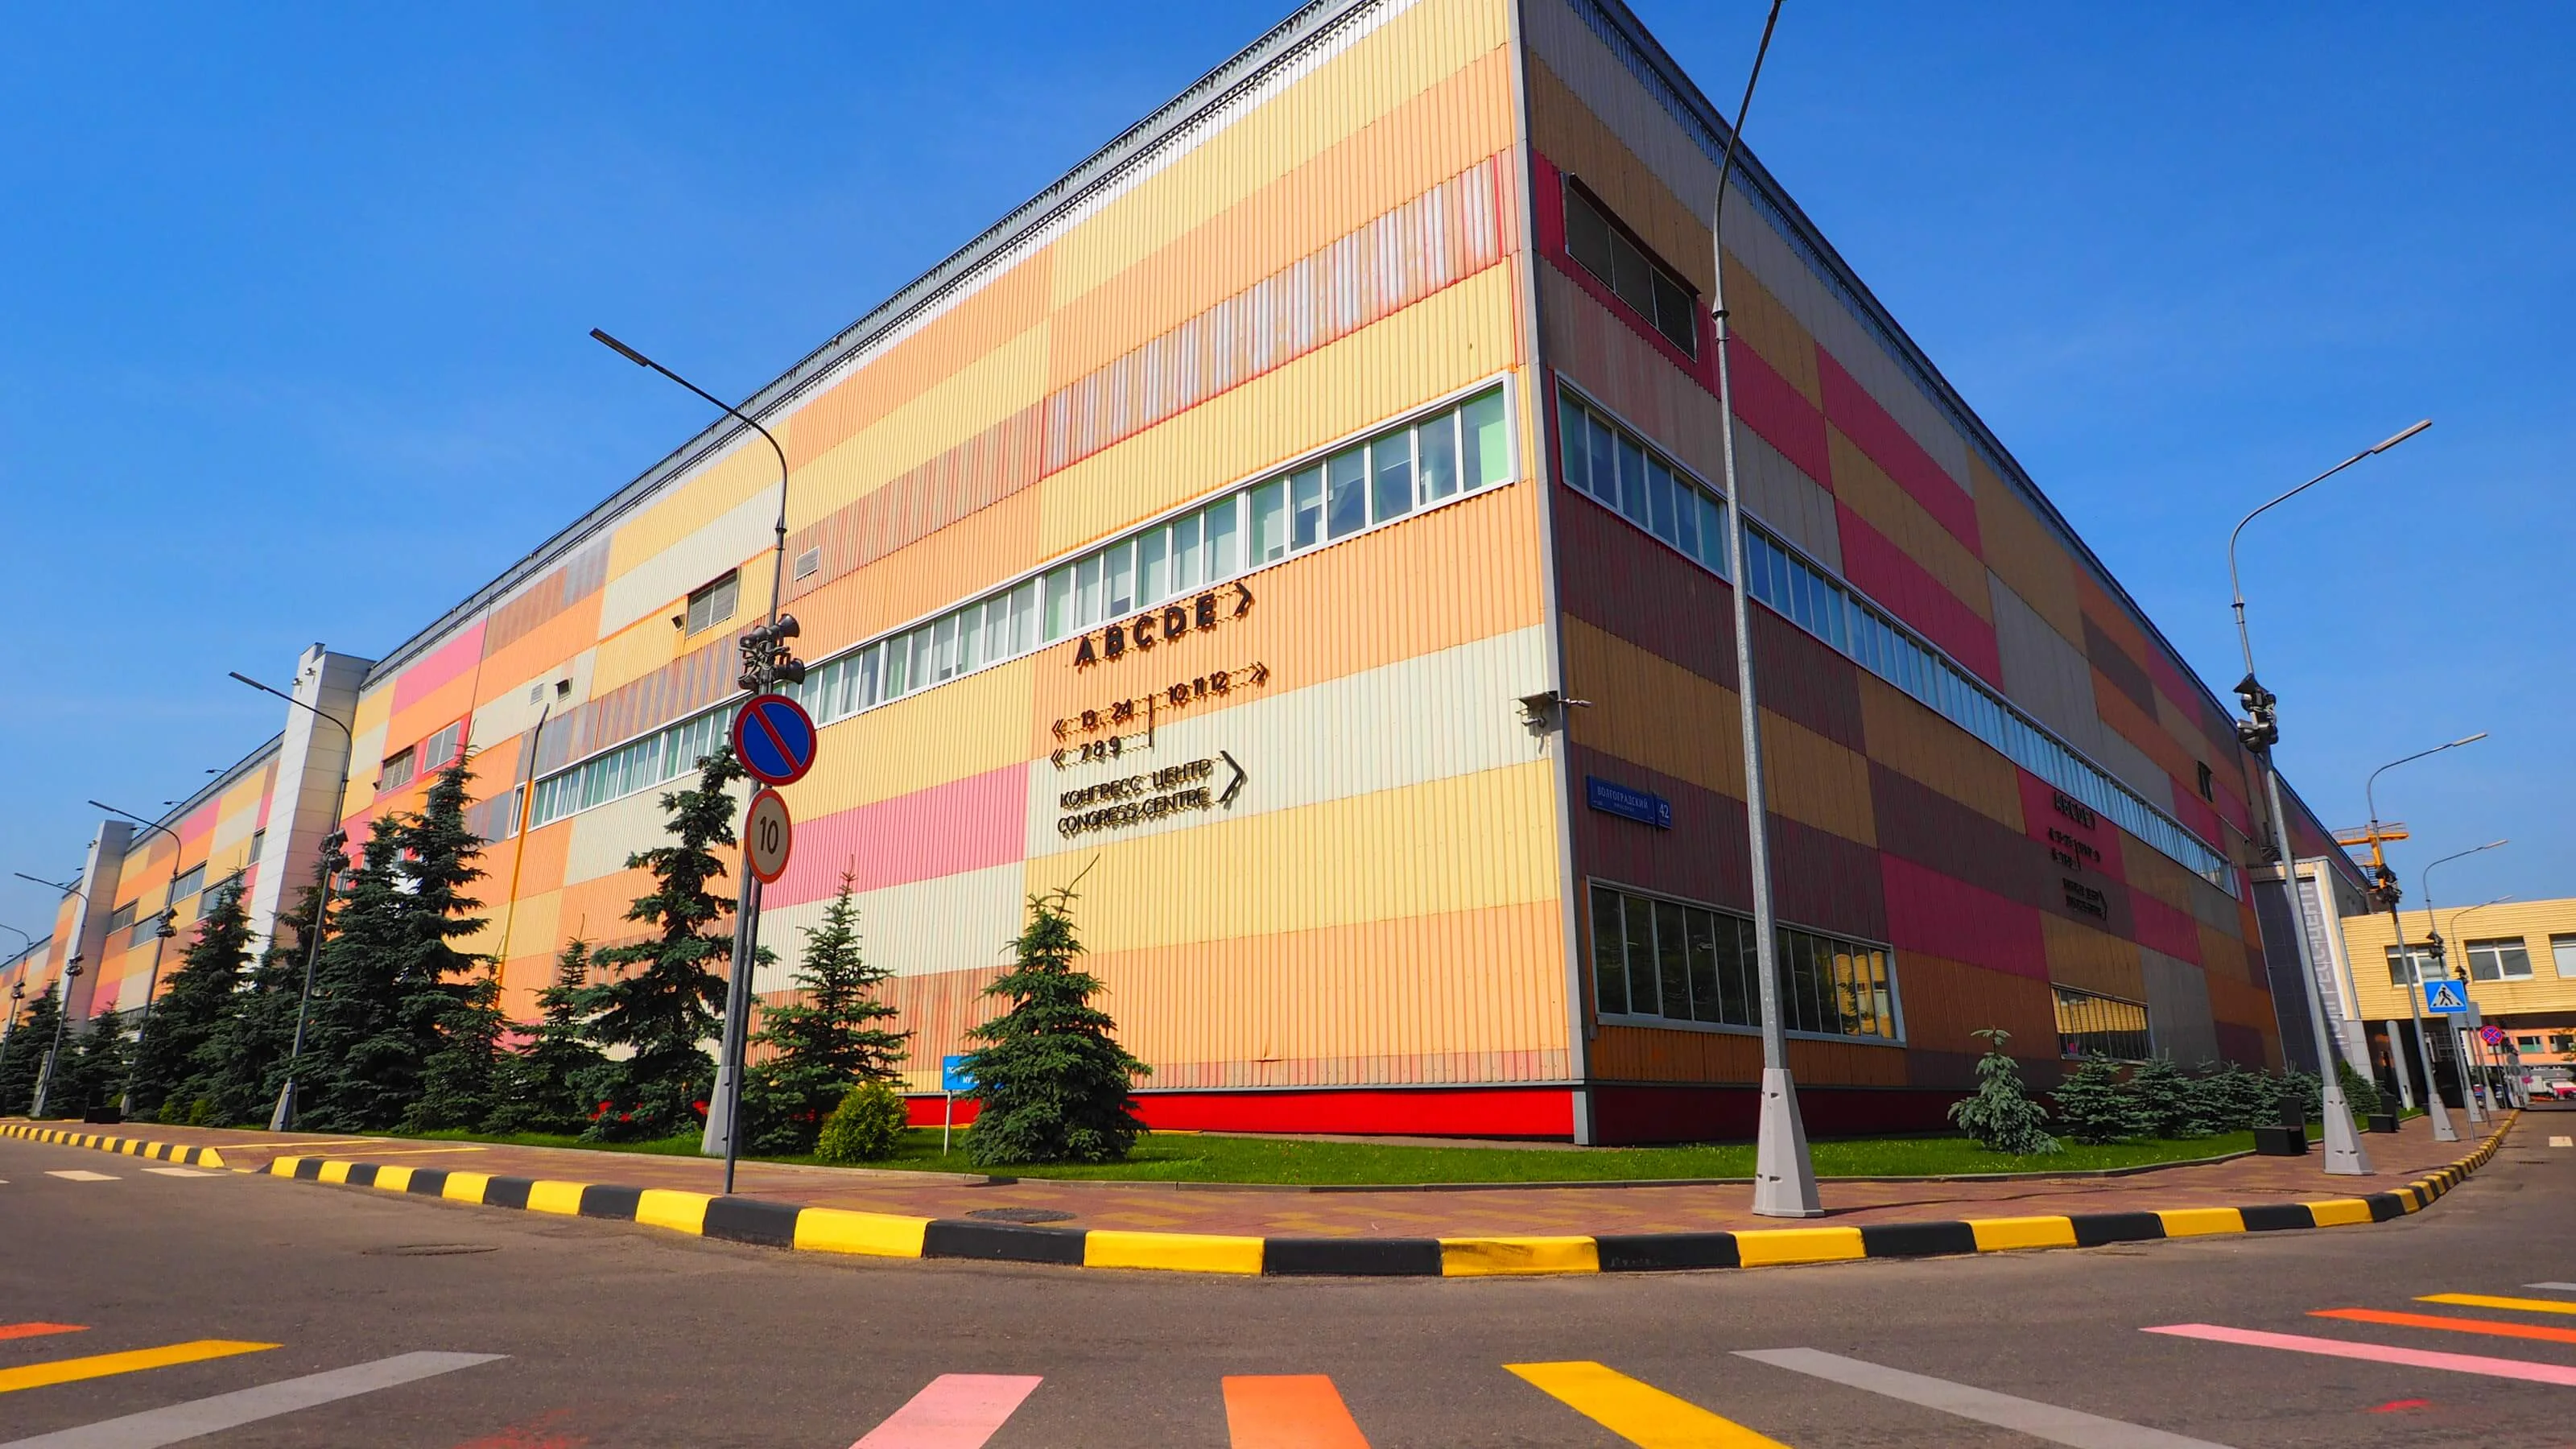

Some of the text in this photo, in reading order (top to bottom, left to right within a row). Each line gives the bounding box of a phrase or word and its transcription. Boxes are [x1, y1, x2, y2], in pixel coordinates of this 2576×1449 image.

[1167, 683, 1188, 705] 10
[1209, 671, 1227, 691] 12
[1112, 698, 1132, 720] 24
[1059, 758, 1211, 808] КОНГРЕСС ЦЕНТР
[1057, 786, 1209, 834] CONGRESS CENTRE
[1659, 803, 1670, 818] 42
[760, 815, 778, 854] 10
